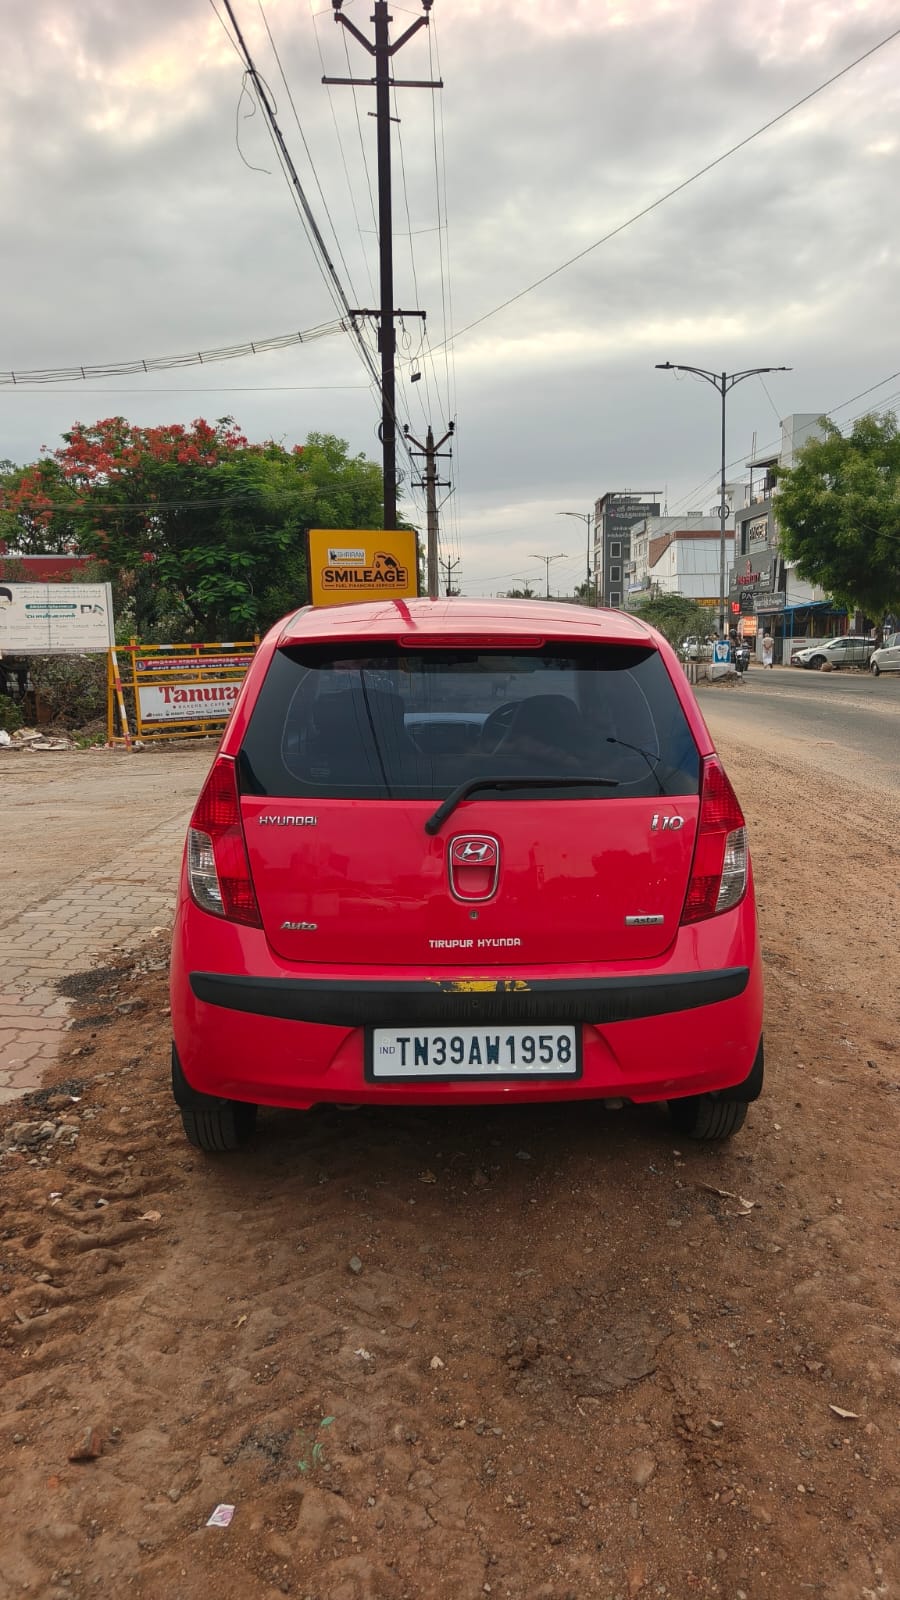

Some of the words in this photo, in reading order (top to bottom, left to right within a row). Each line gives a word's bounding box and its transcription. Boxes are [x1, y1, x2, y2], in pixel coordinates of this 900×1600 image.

[324, 570, 406, 583] SMILEAGE
[258, 816, 318, 826] HYUNDAI
[280, 921, 318, 931] Auto
[428, 939, 474, 949] TIRUPUR
[379, 1046, 396, 1055] IND
[396, 1035, 572, 1067] TN39AW1958
